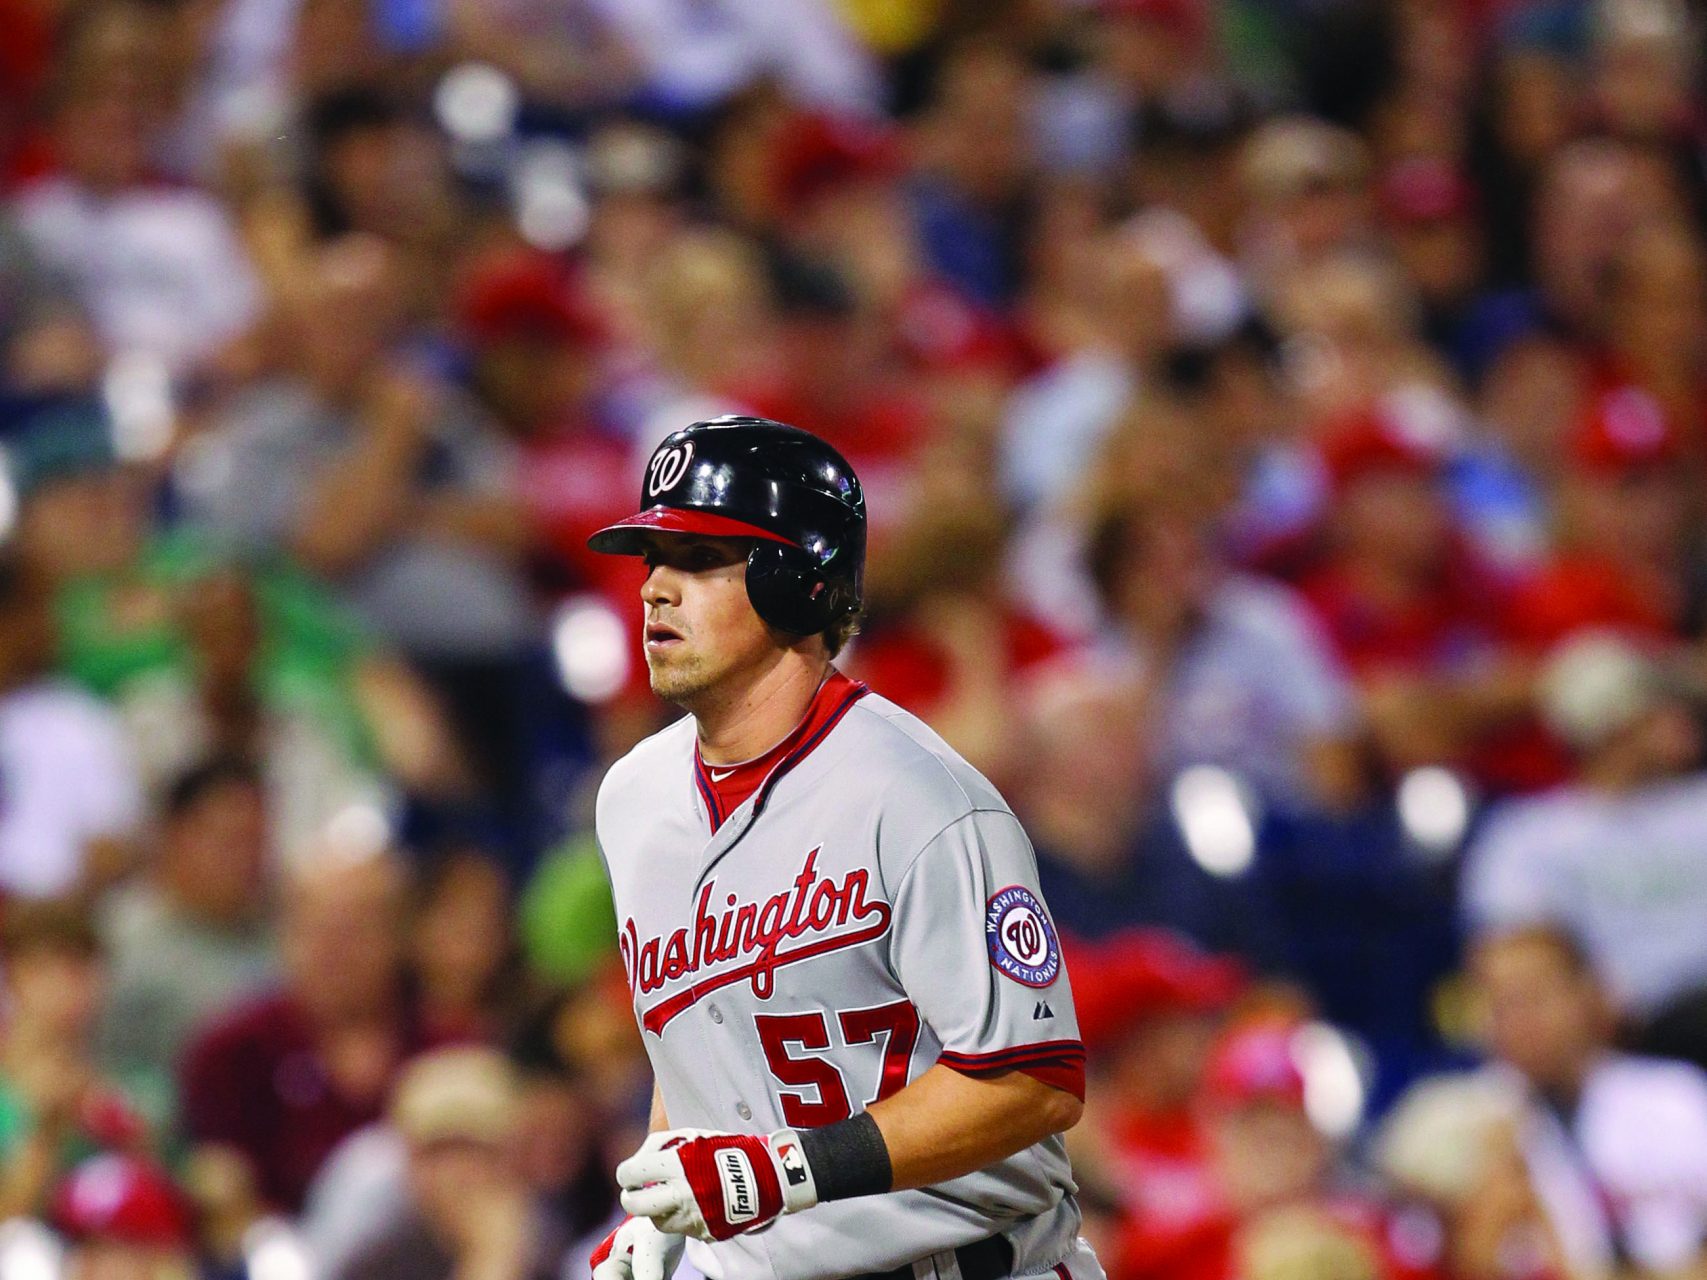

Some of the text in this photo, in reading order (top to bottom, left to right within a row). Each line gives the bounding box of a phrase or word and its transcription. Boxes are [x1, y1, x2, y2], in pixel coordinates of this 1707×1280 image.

[650, 442, 694, 497] W
[987, 890, 1047, 933] WASHINGTON
[1007, 914, 1040, 960] W
[1000, 950, 1058, 982] NATIONALS
[752, 998, 923, 1131] 57
[727, 1154, 755, 1216] Franklin
